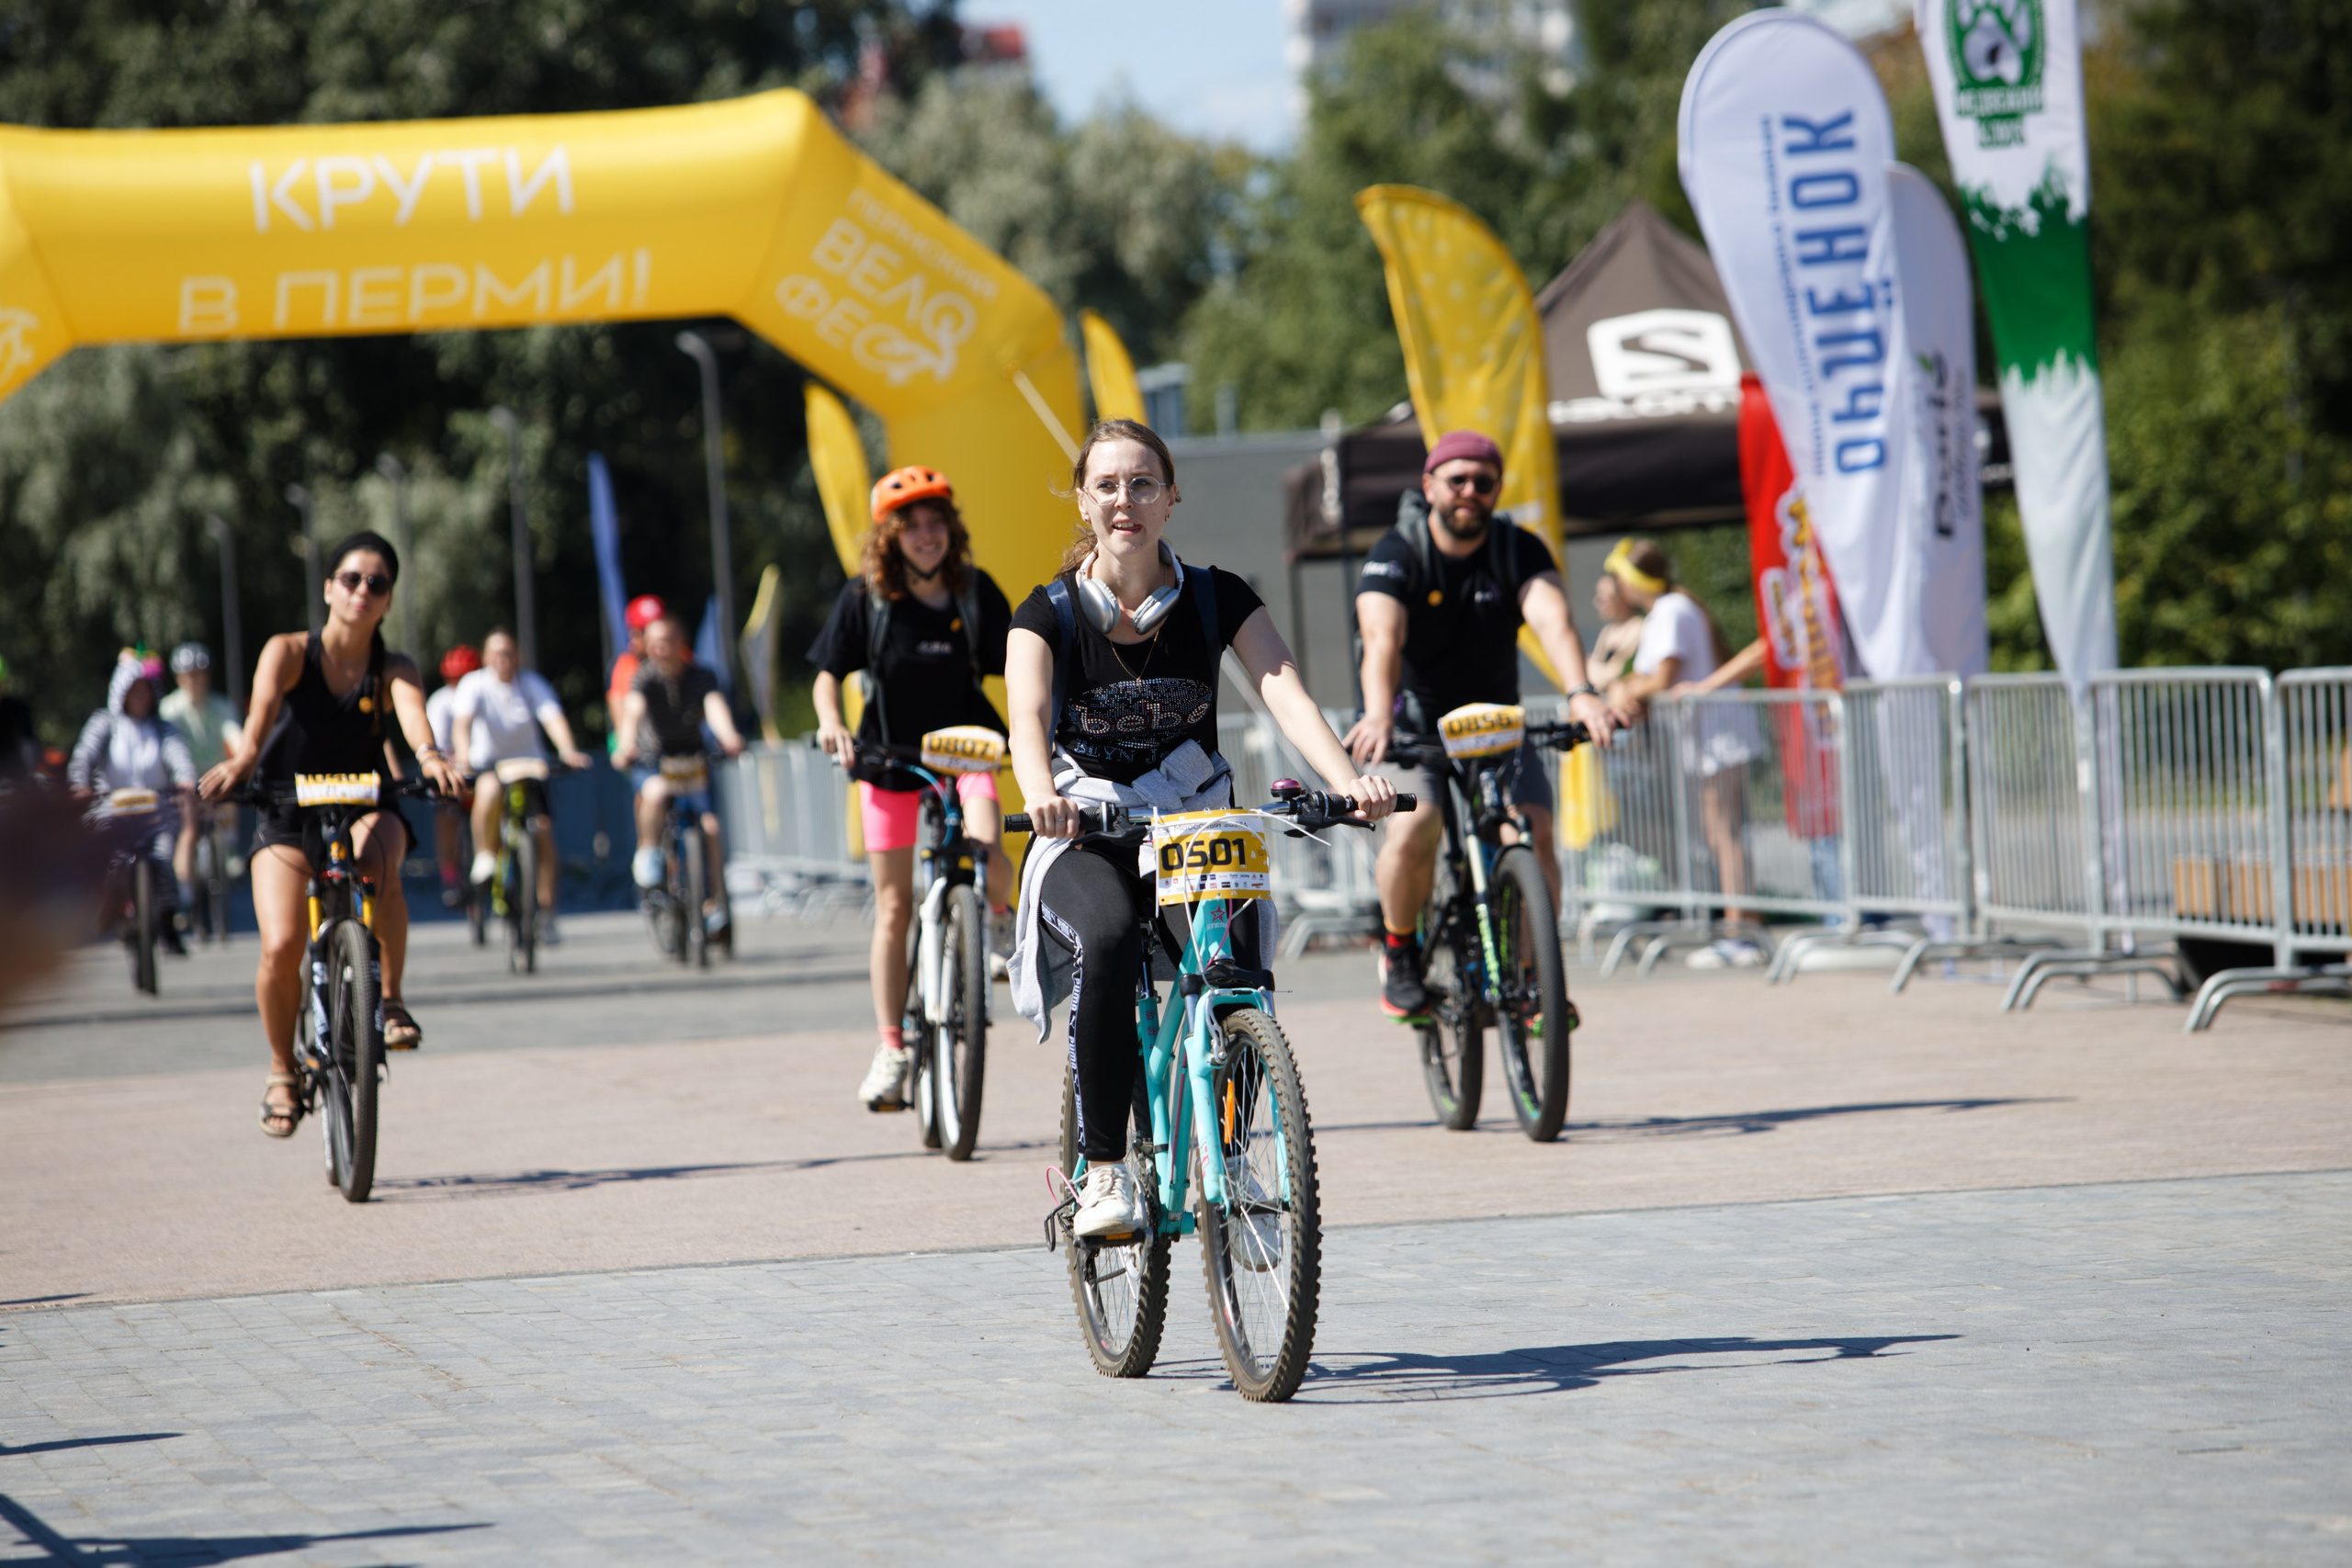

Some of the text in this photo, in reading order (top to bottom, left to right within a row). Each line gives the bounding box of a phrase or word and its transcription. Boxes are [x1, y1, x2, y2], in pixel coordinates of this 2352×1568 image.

[249, 144, 574, 233] КРУТИ
[178, 247, 650, 336] В ПЕРМИ!
[1074, 702, 1209, 735] bebe
[1160, 837, 1247, 872] 0501
